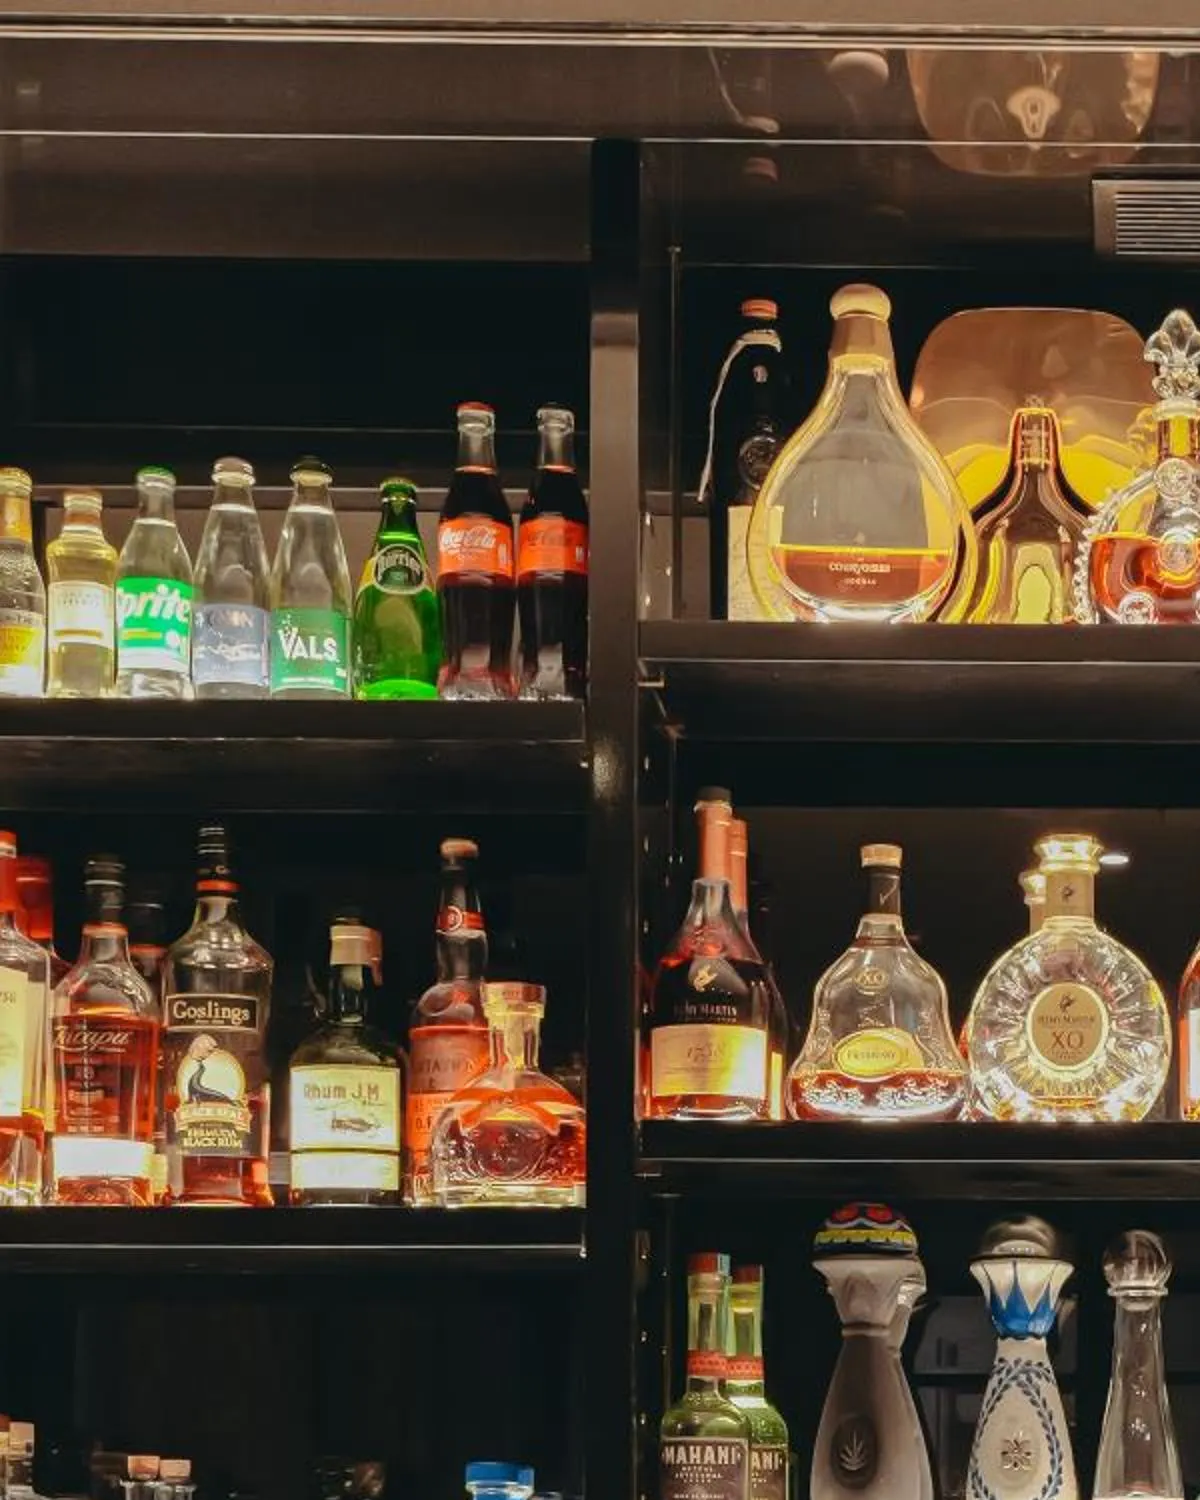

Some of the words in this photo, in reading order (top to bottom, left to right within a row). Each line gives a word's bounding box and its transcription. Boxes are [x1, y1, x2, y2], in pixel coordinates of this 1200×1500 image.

[277, 627, 337, 661] VALS
[173, 1000, 250, 1025] Goslings
[1051, 1030, 1085, 1049] XO
[303, 1082, 347, 1099] Rhum
